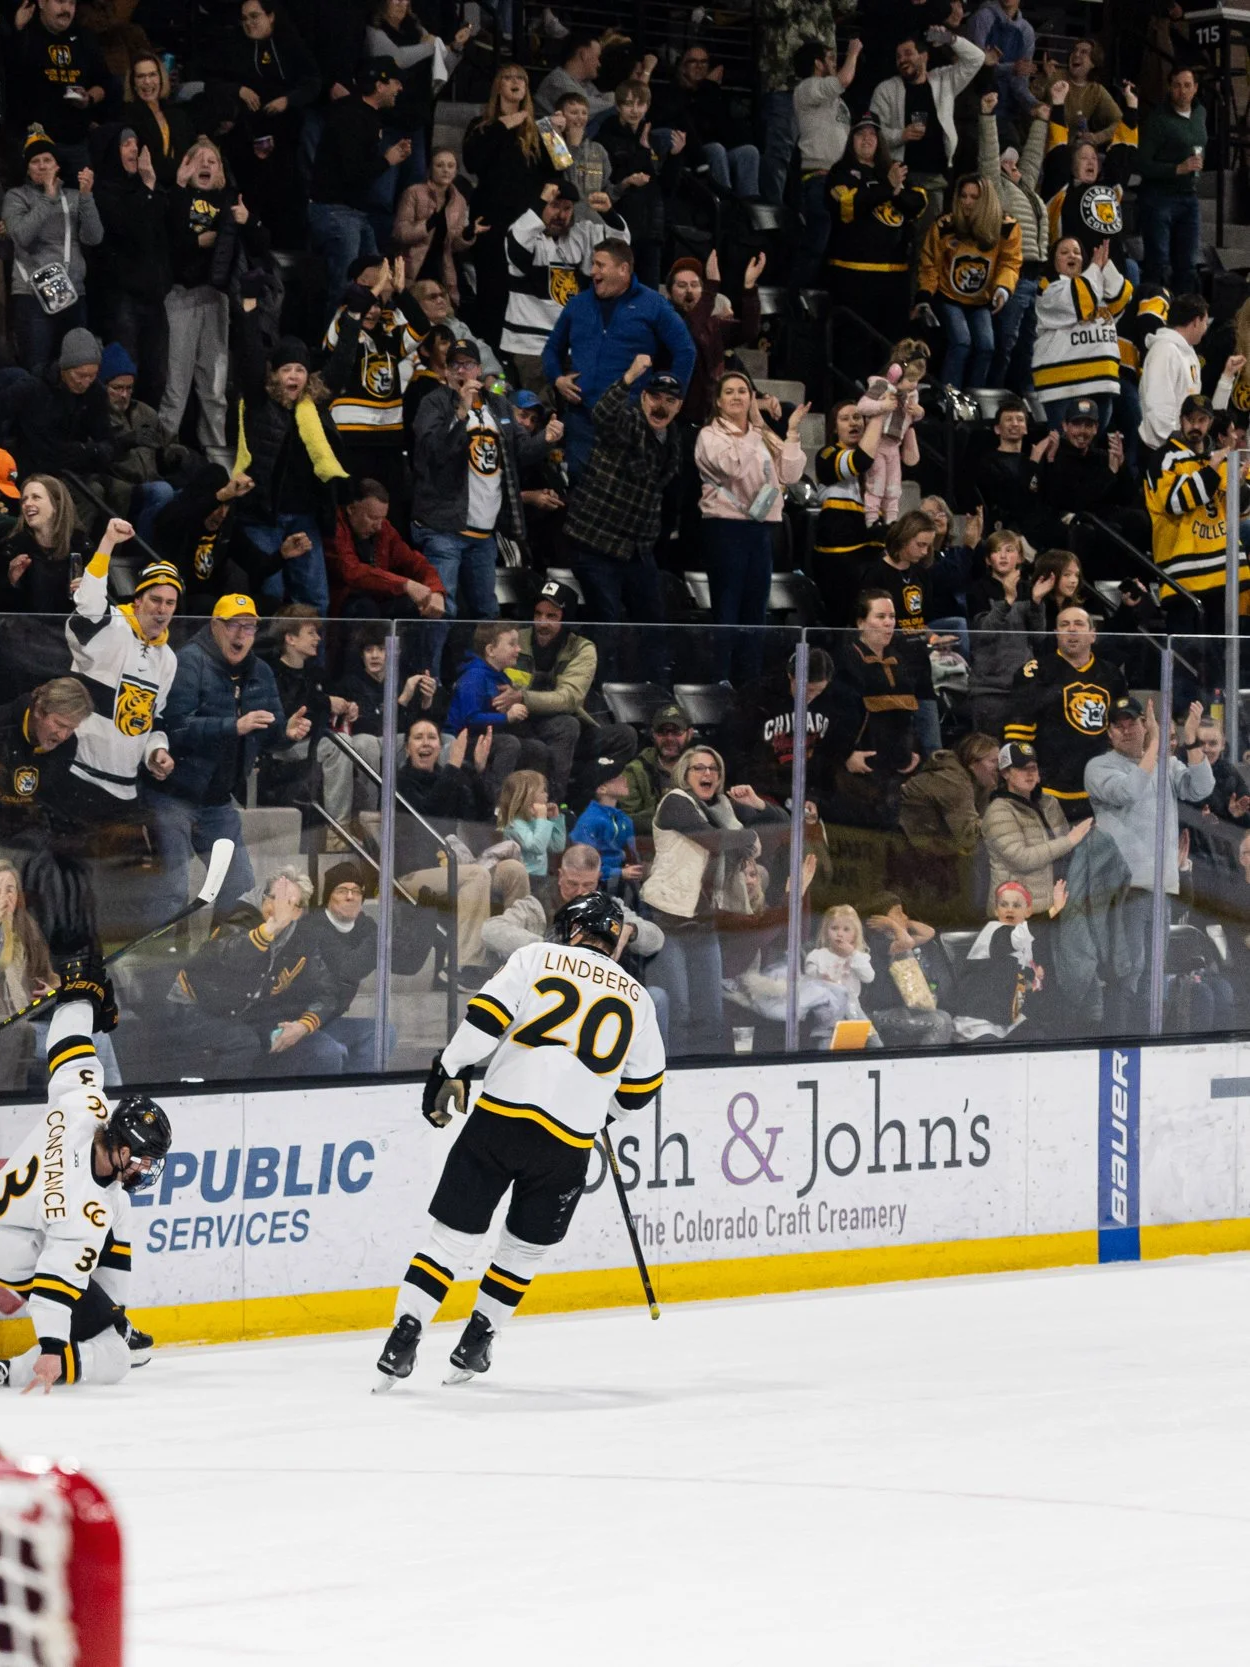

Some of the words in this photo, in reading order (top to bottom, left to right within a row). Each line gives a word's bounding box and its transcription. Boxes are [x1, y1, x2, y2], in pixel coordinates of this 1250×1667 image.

[1195, 25, 1221, 45] 115
[1070, 329, 1118, 346] COLLEG
[1192, 520, 1227, 540] COLLE
[544, 951, 642, 1002] LINDBERG
[511, 975, 634, 1077] 20
[721, 1091, 785, 1186] &
[797, 1069, 992, 1199] John's
[1111, 1050, 1129, 1227] BAUER
[44, 1110, 67, 1219] CONSTANCE
[146, 1208, 311, 1254] SERVICES
[673, 1206, 759, 1244] Colorado
[765, 1202, 812, 1235] Craft
[817, 1201, 908, 1235] Creamery
[74, 1246, 98, 1273] 3
